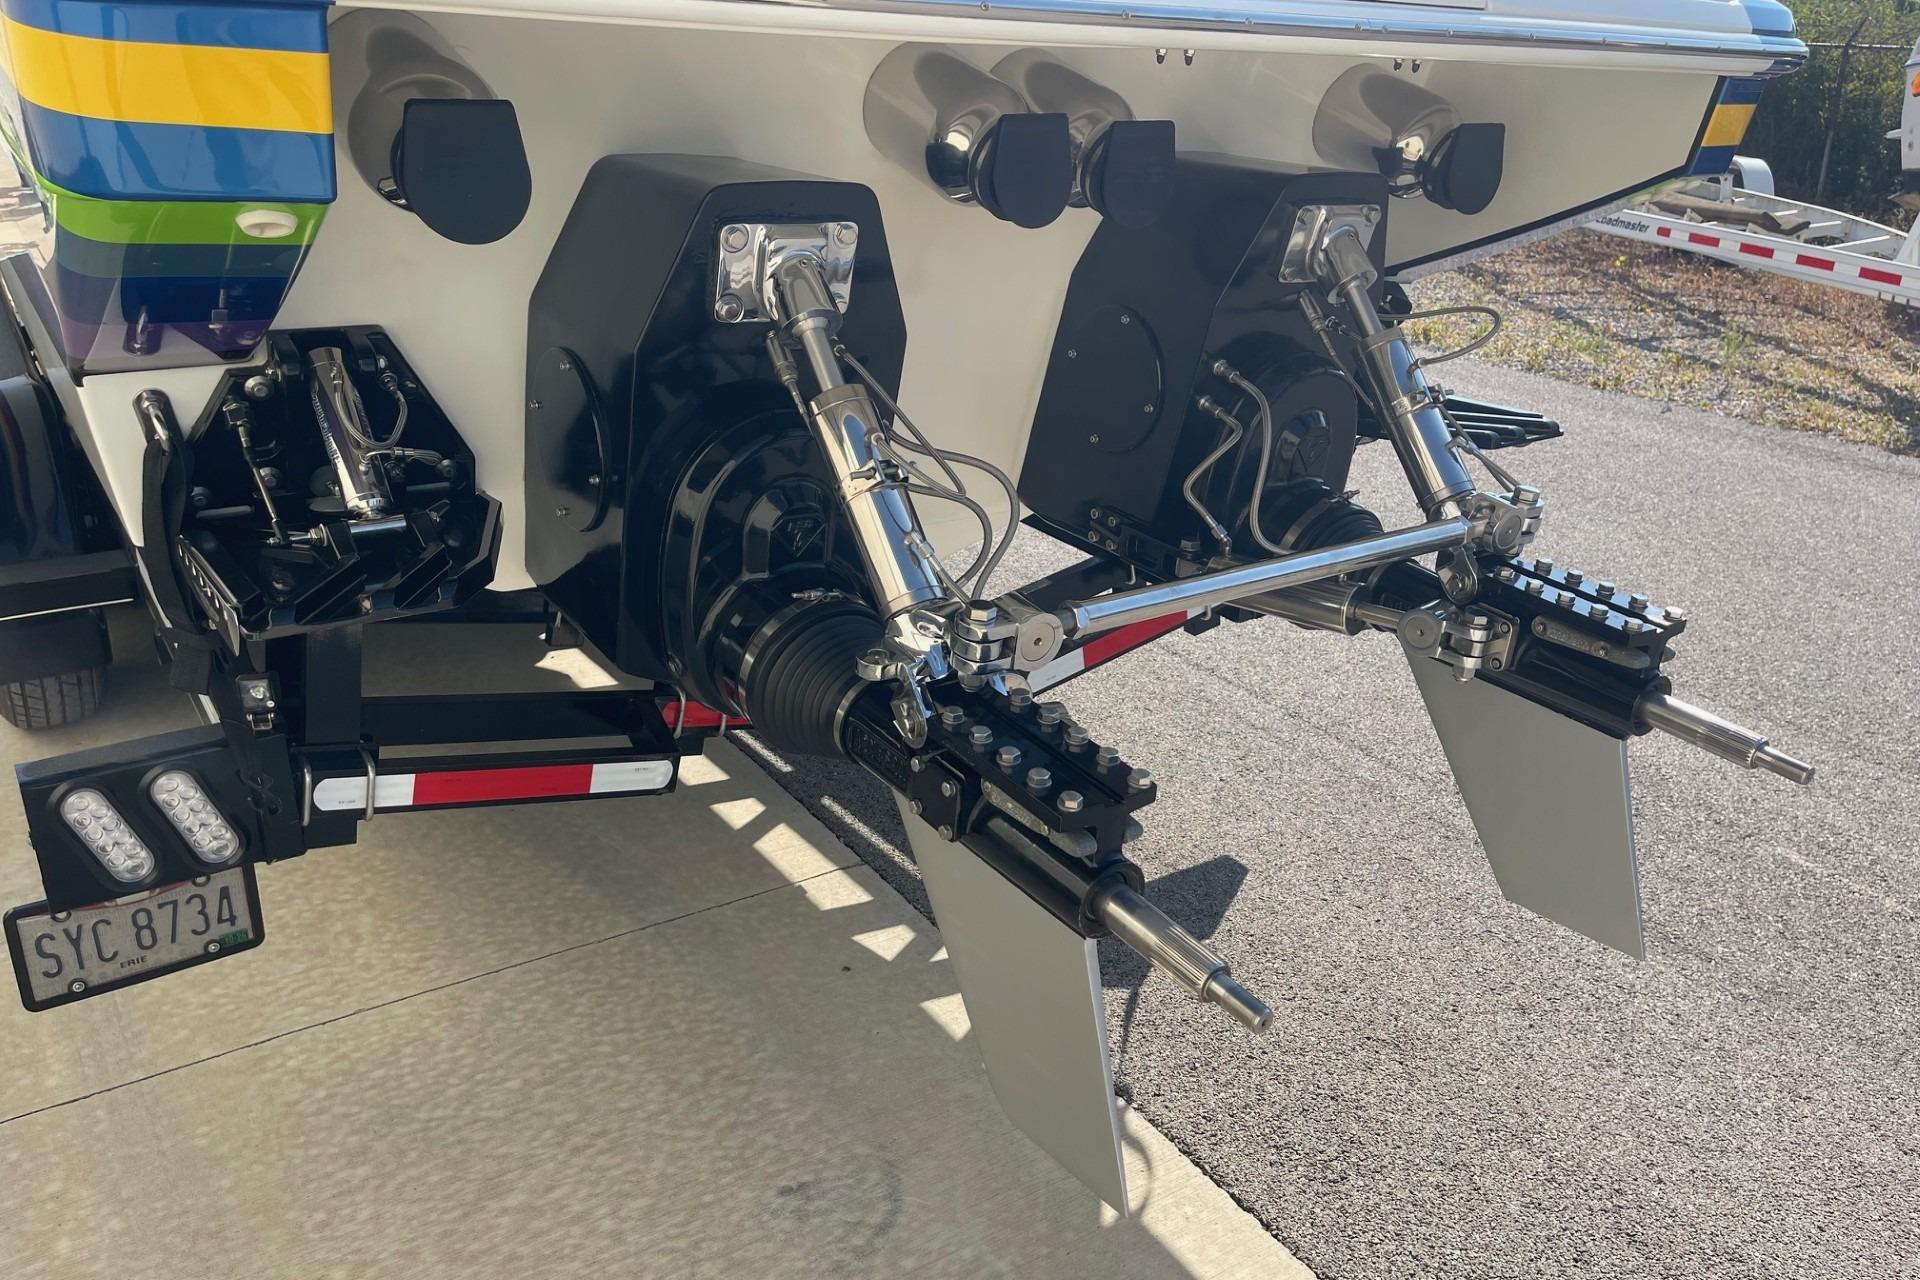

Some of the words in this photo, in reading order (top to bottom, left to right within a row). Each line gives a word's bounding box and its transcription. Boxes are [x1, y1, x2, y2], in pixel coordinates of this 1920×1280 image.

[34, 918, 119, 978] SYC
[131, 885, 238, 950] 8734
[120, 955, 148, 969] ERIE
